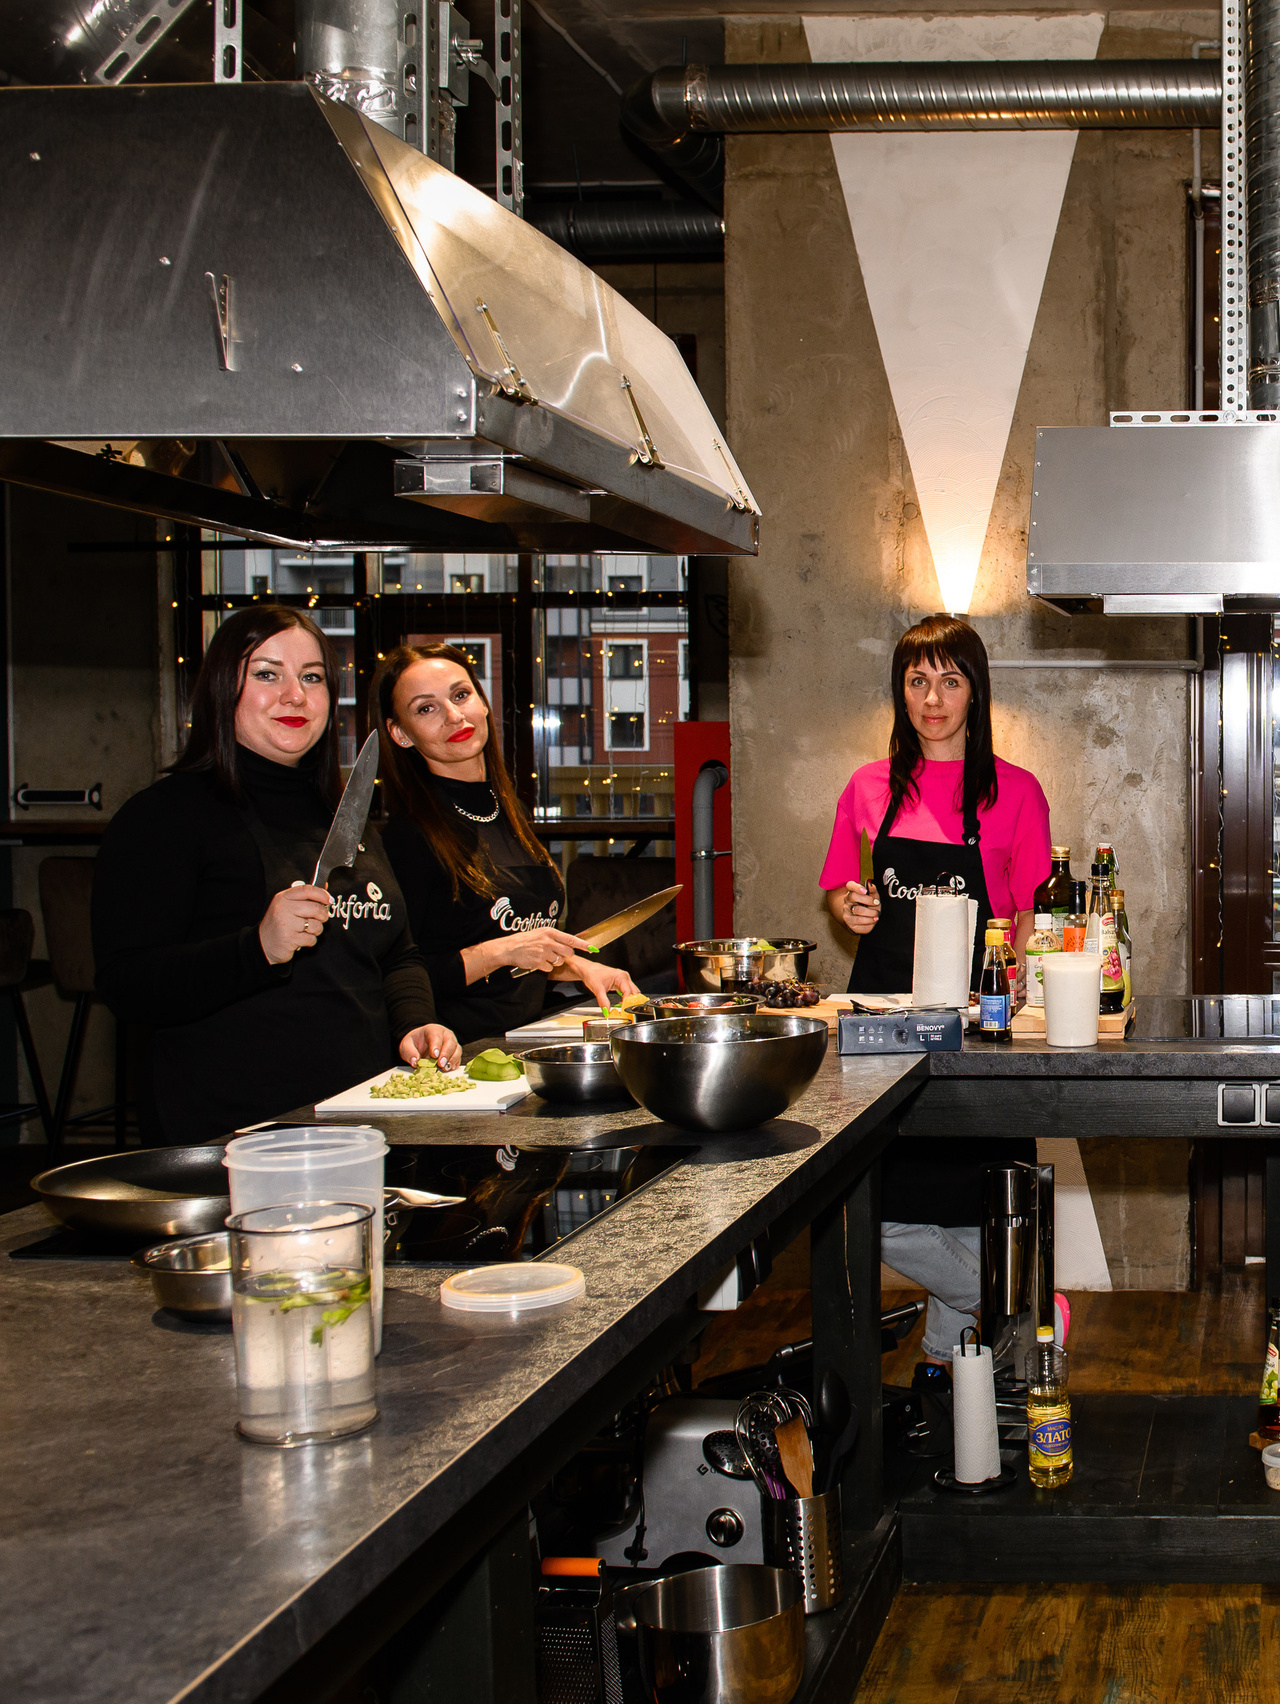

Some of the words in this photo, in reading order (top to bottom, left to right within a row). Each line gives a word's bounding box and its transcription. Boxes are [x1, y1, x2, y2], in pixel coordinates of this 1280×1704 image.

[328, 885, 392, 930] okforia
[919, 1034, 925, 1042] L
[1035, 1427, 1072, 1443] ЗЛАТО
